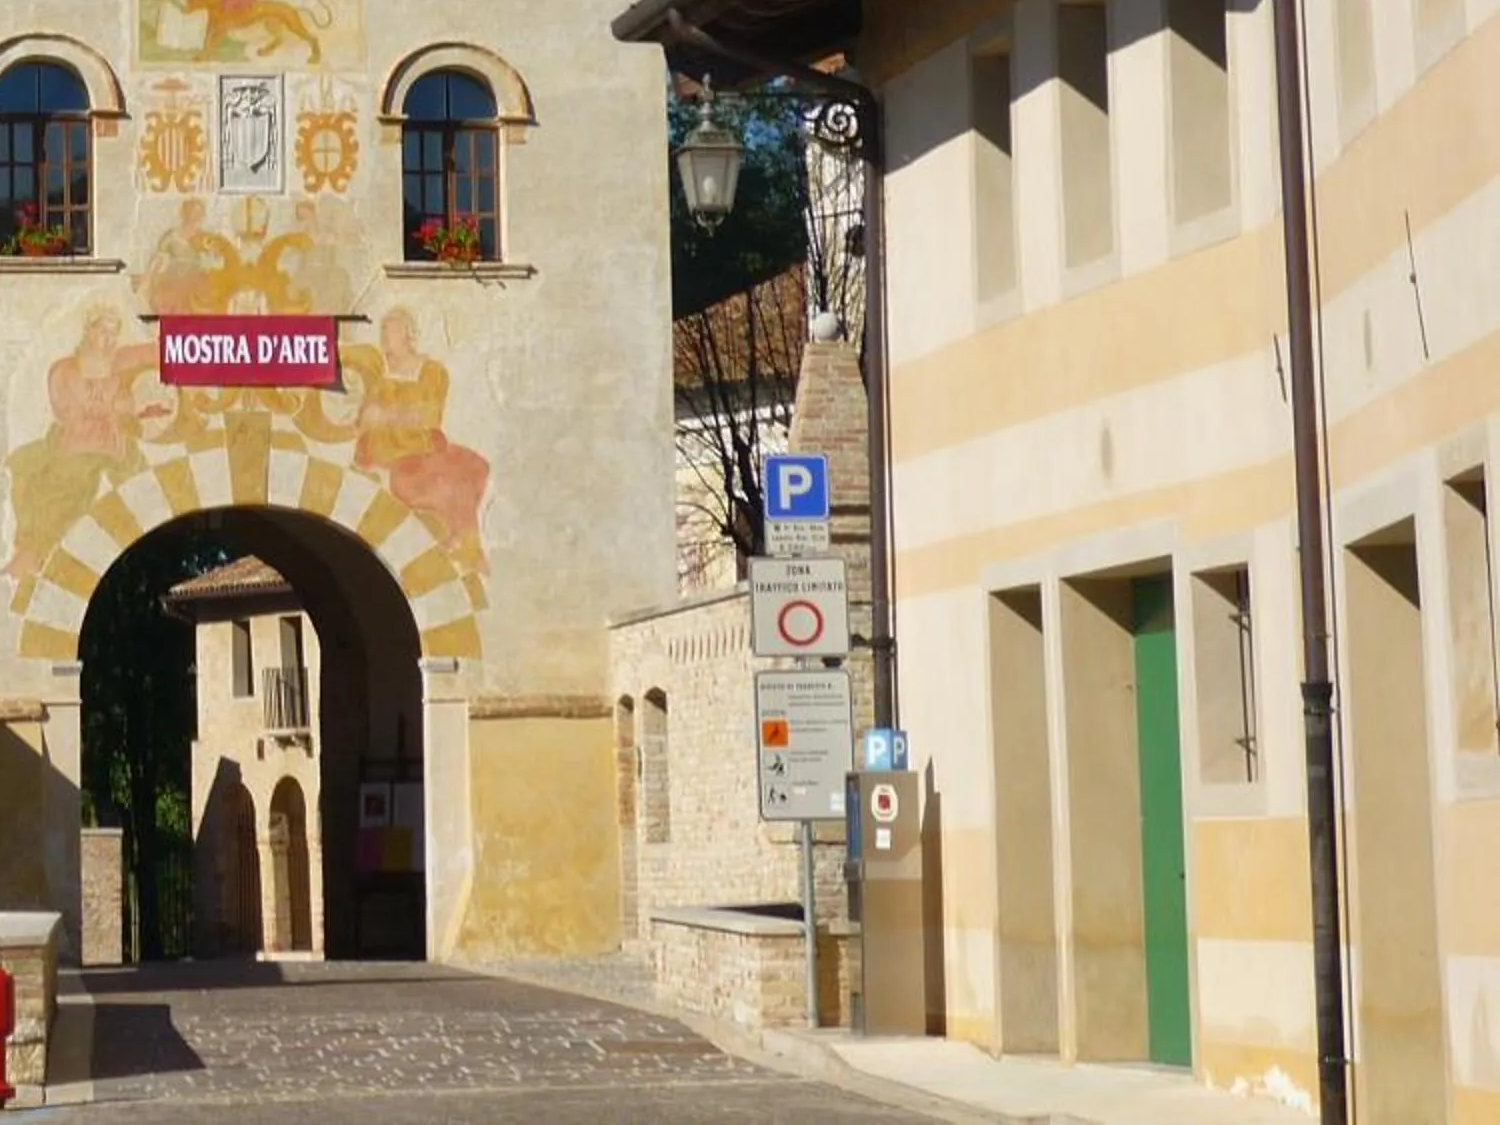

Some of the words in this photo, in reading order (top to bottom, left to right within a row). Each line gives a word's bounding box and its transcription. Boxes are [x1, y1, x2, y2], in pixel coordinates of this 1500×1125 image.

[165, 334, 251, 364] MOSTRA
[257, 334, 329, 364] D'ARTE
[779, 464, 813, 510] P
[787, 564, 811, 576] ZONA
[867, 736, 886, 765] P
[893, 736, 905, 765] P
